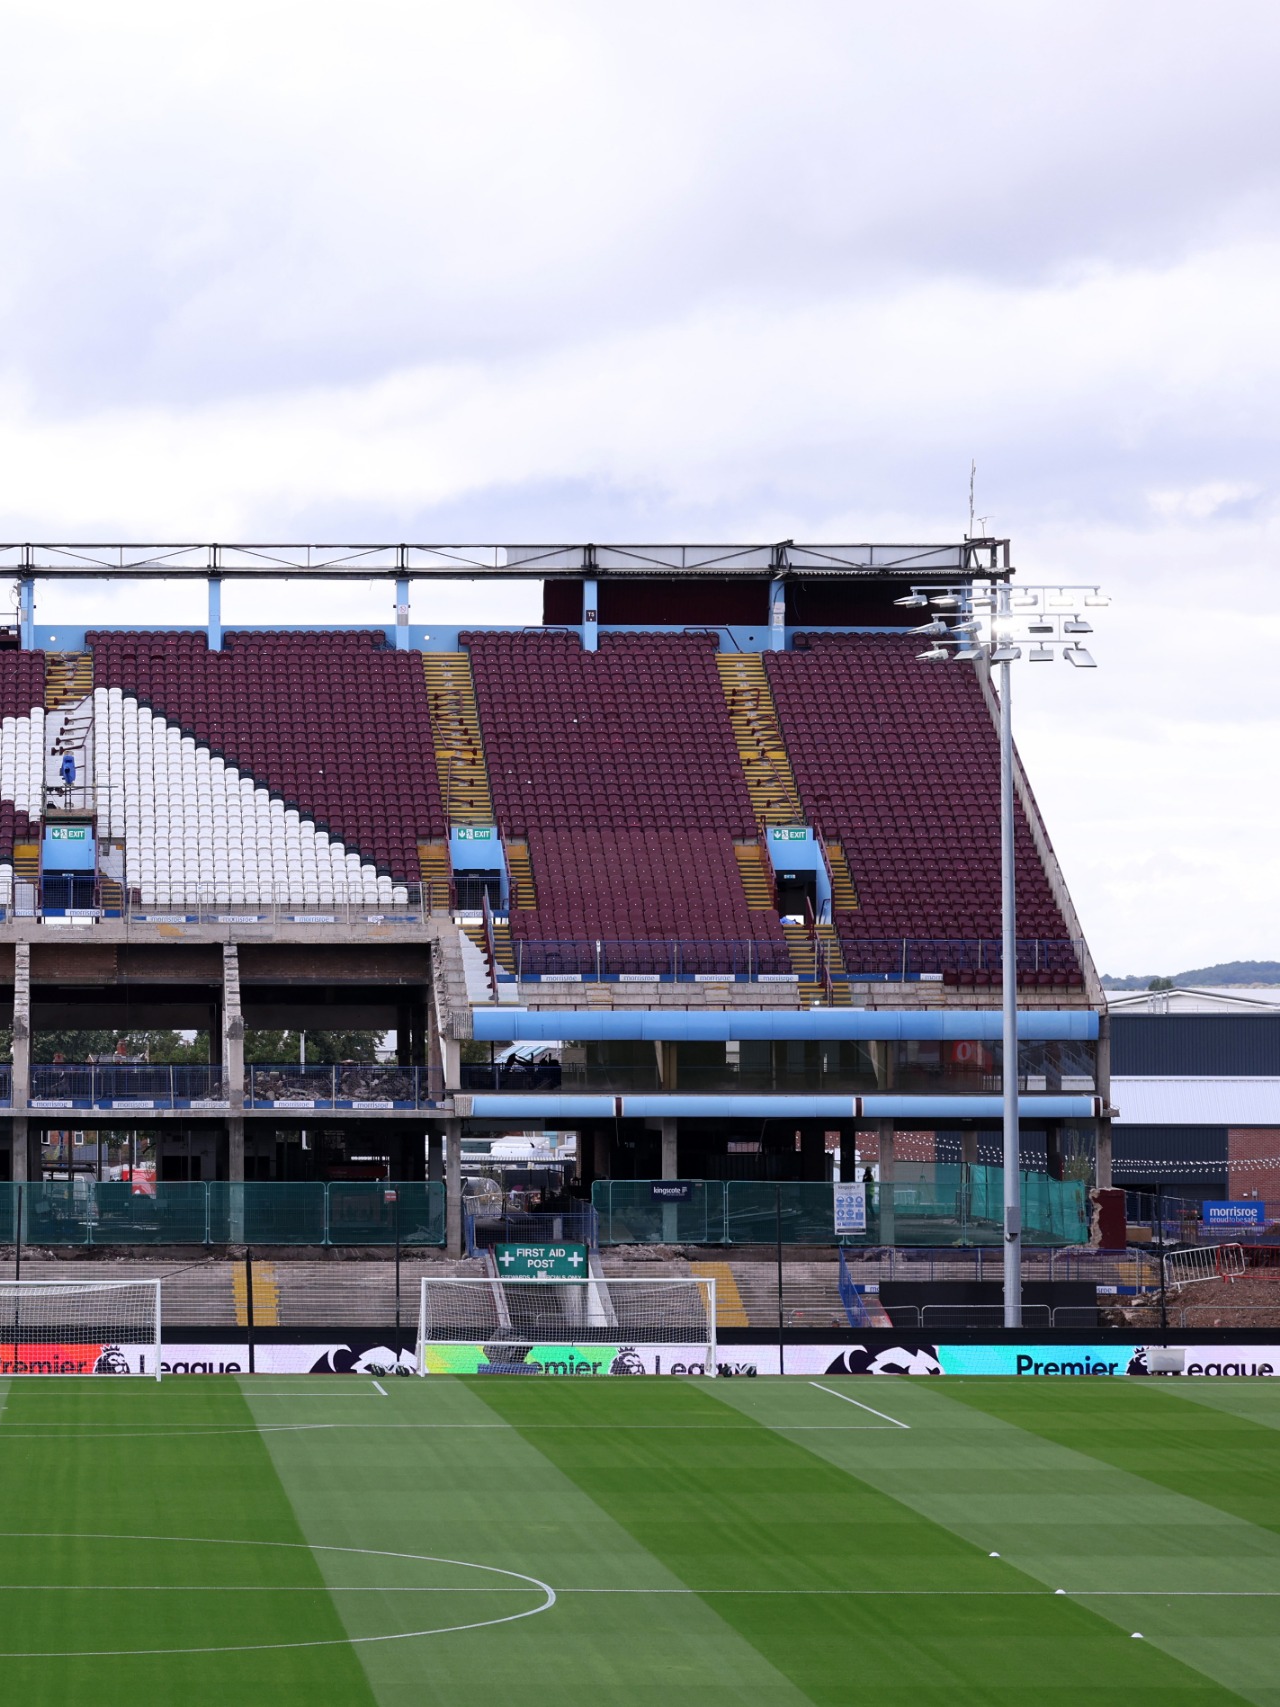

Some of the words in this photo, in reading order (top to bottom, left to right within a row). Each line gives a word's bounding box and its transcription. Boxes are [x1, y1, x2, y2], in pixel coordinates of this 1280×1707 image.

[654, 1186, 680, 1195] kingscote
[1210, 1206, 1258, 1216] morrisroe
[516, 1248, 545, 1257] FIRST
[549, 1248, 566, 1257] AID
[528, 1260, 554, 1268] POST
[531, 1354, 602, 1374] emier
[1017, 1354, 1118, 1375] Premier
[1187, 1363, 1274, 1376] eague
